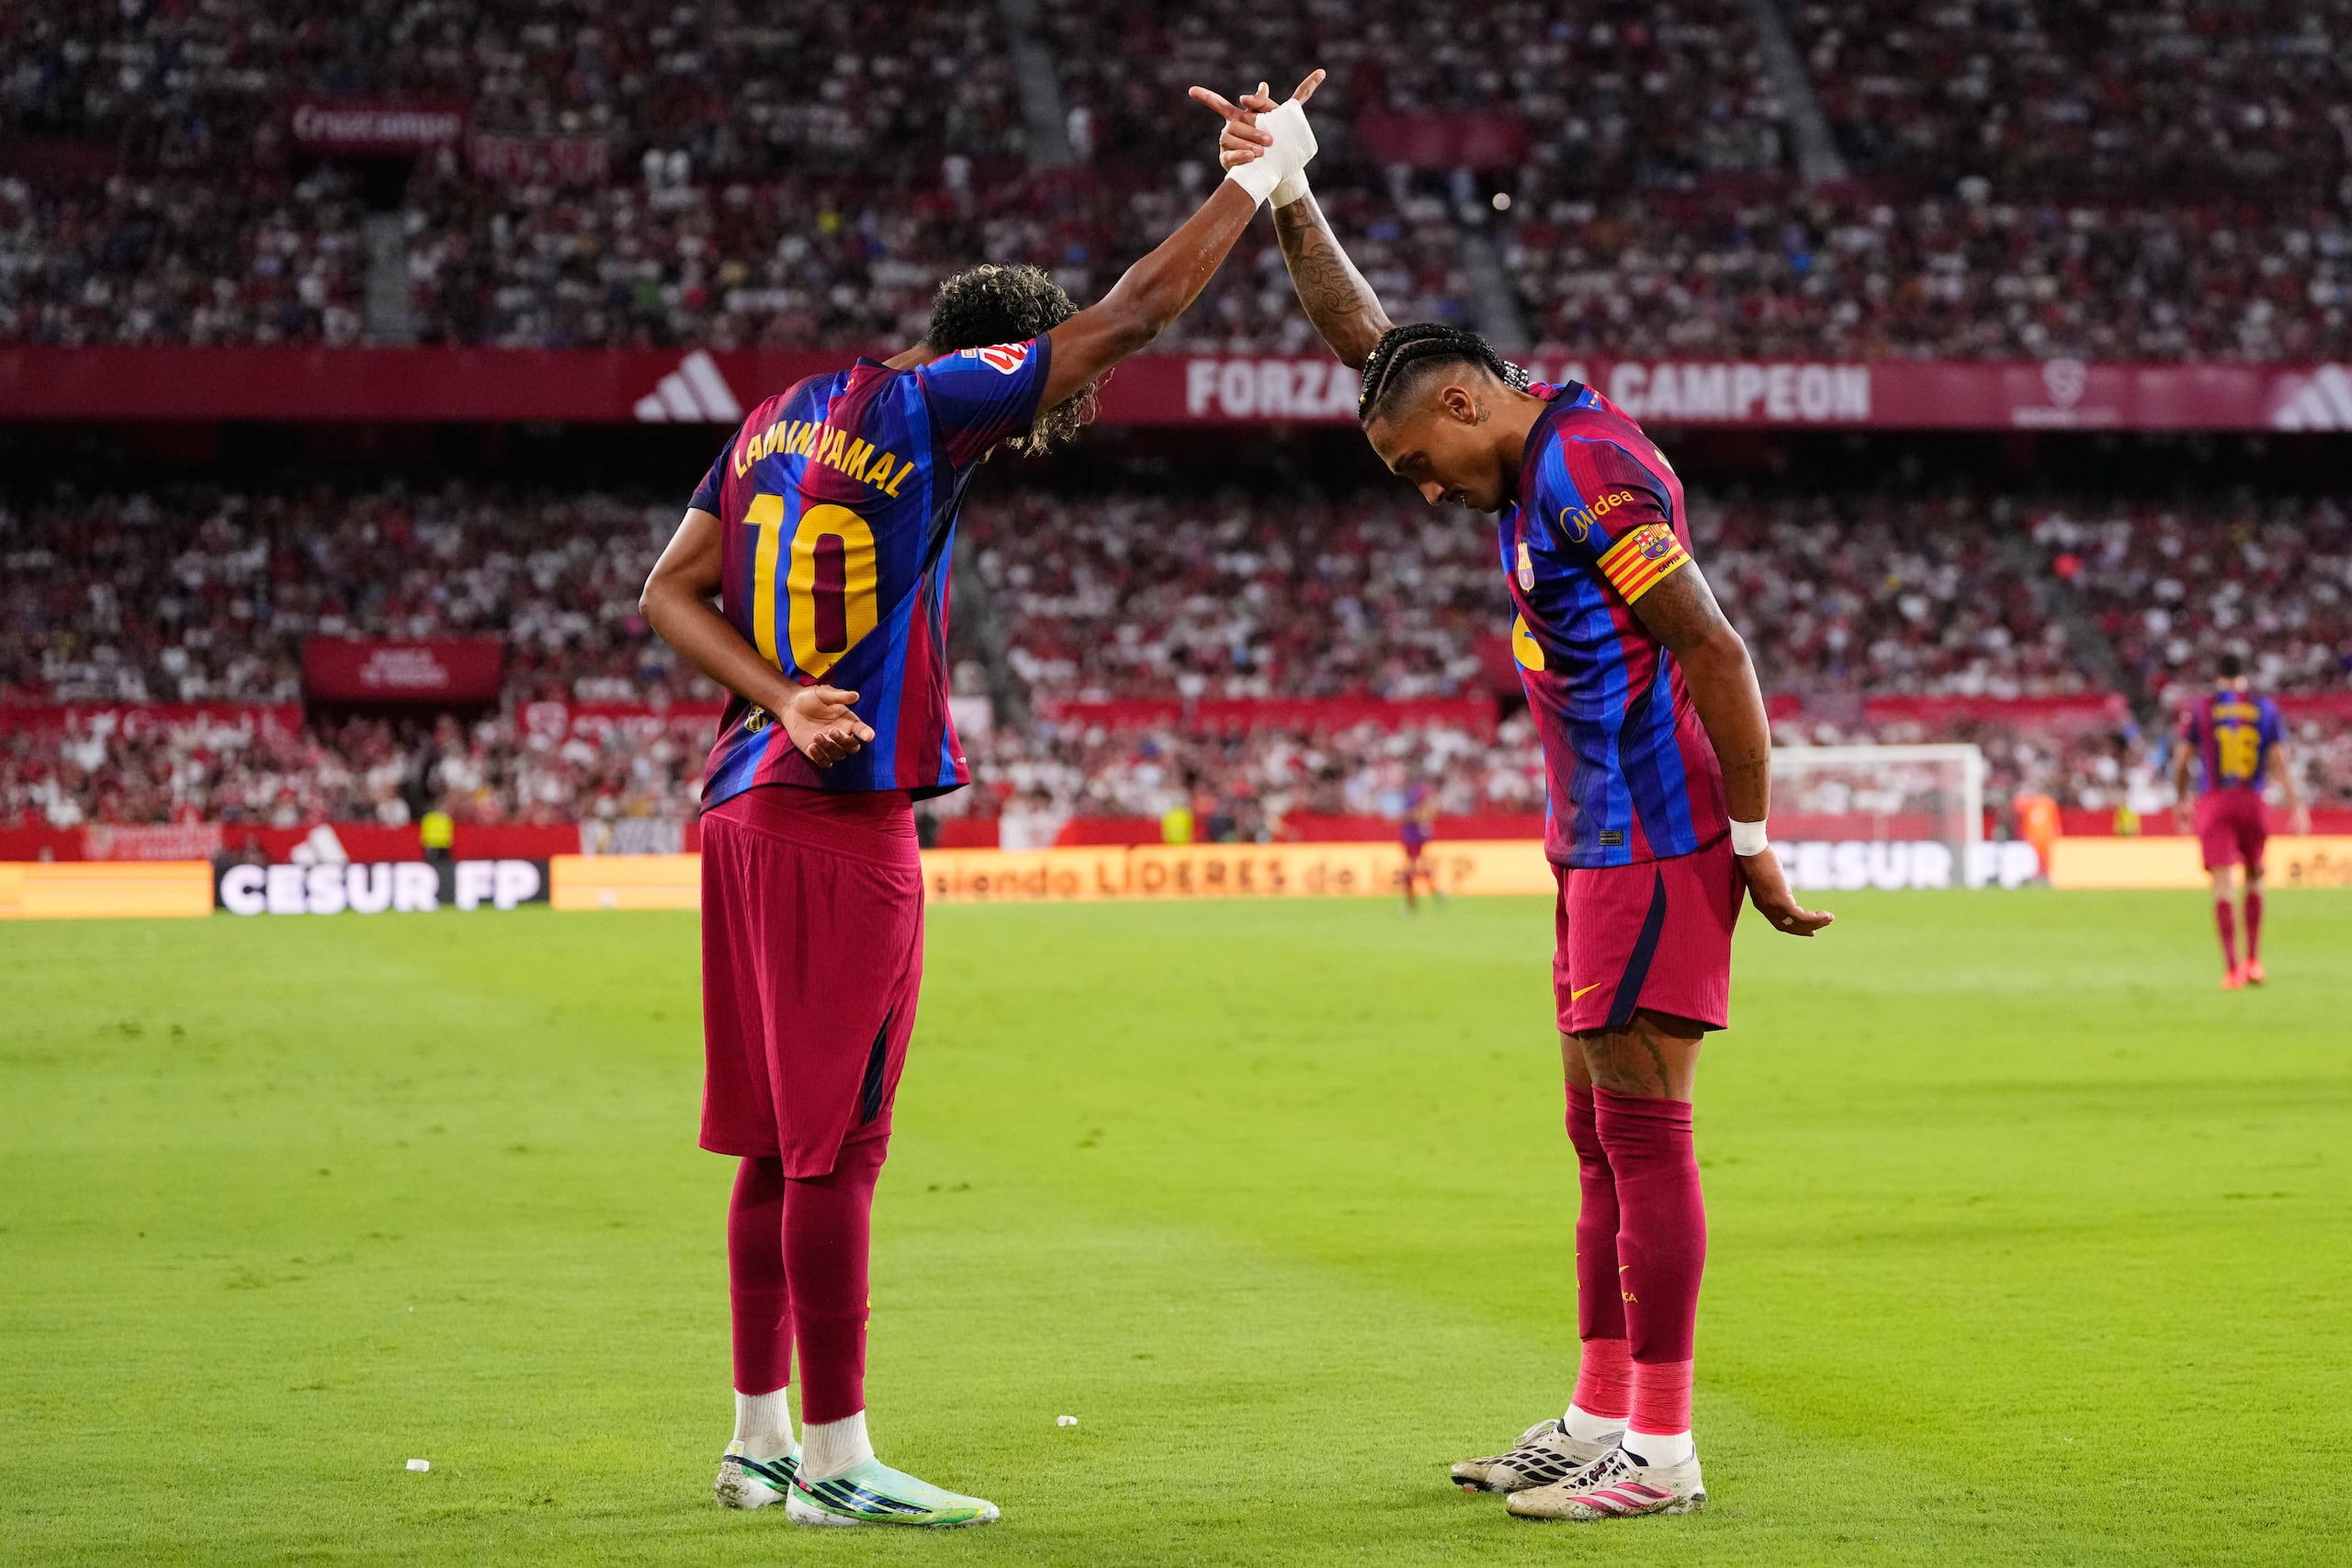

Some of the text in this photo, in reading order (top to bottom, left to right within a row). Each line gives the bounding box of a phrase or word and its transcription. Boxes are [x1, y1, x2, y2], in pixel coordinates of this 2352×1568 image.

[1186, 359, 1361, 419] FORZA
[1610, 361, 1871, 422] CAMPEON
[814, 424, 915, 499] YAMAL
[1559, 491, 1635, 544] Midea
[741, 493, 878, 679] 10
[2214, 725, 2261, 779] 16
[220, 859, 540, 916] CESUR FP
[1963, 840, 2039, 889] FP
